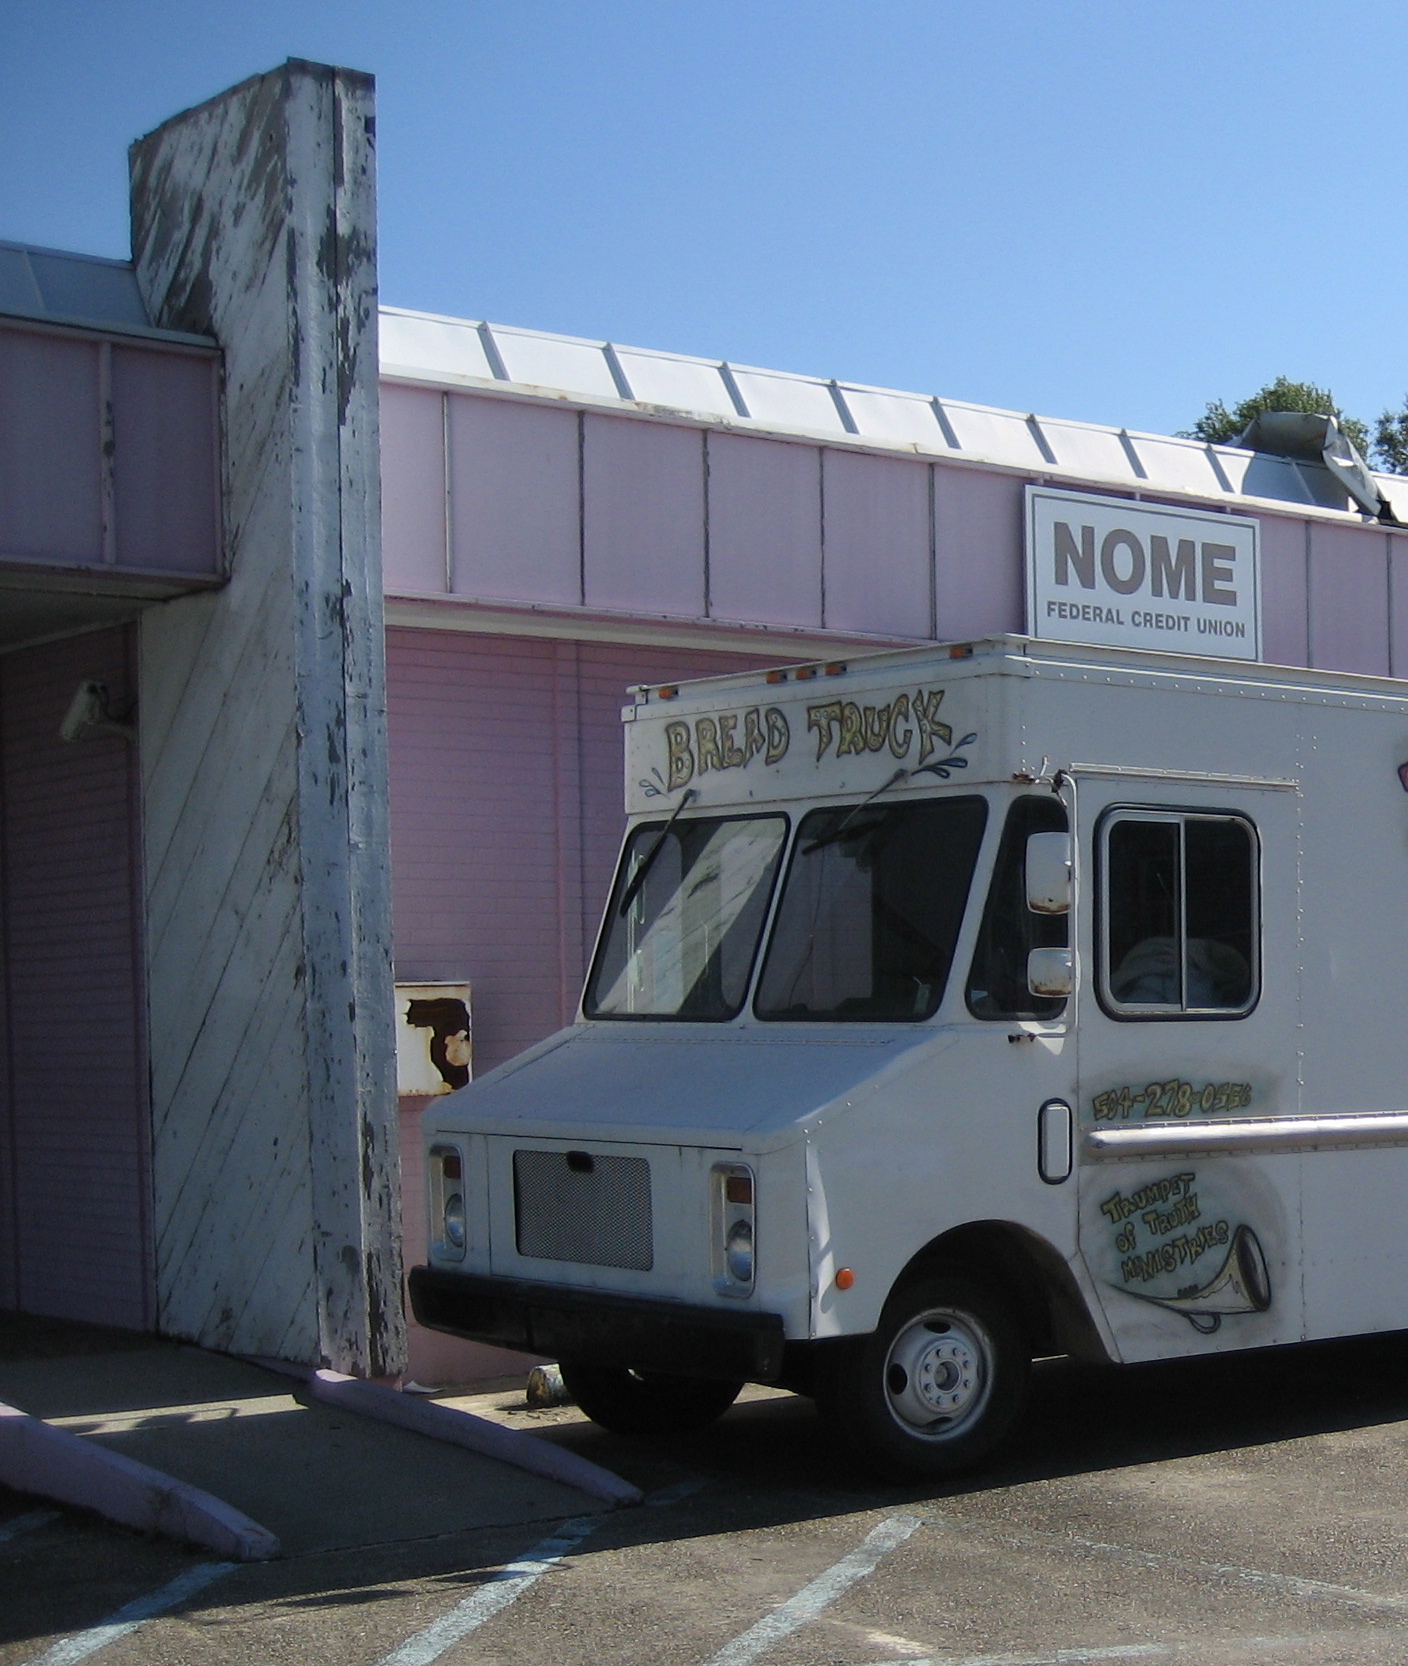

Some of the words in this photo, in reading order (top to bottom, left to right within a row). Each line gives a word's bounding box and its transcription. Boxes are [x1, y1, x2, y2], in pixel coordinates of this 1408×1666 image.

[1053, 521, 1237, 607] NOME
[1047, 600, 1125, 626] FEDERAL
[1131, 610, 1190, 632] CREDIT
[1196, 620, 1245, 638] UNION
[665, 707, 790, 792] BREAD
[807, 689, 953, 765] TRUCK
[1101, 1172, 1196, 1224] TRUMPET
[1142, 1192, 1202, 1235] TRUTH
[1120, 1220, 1229, 1282] MINISTRIES
